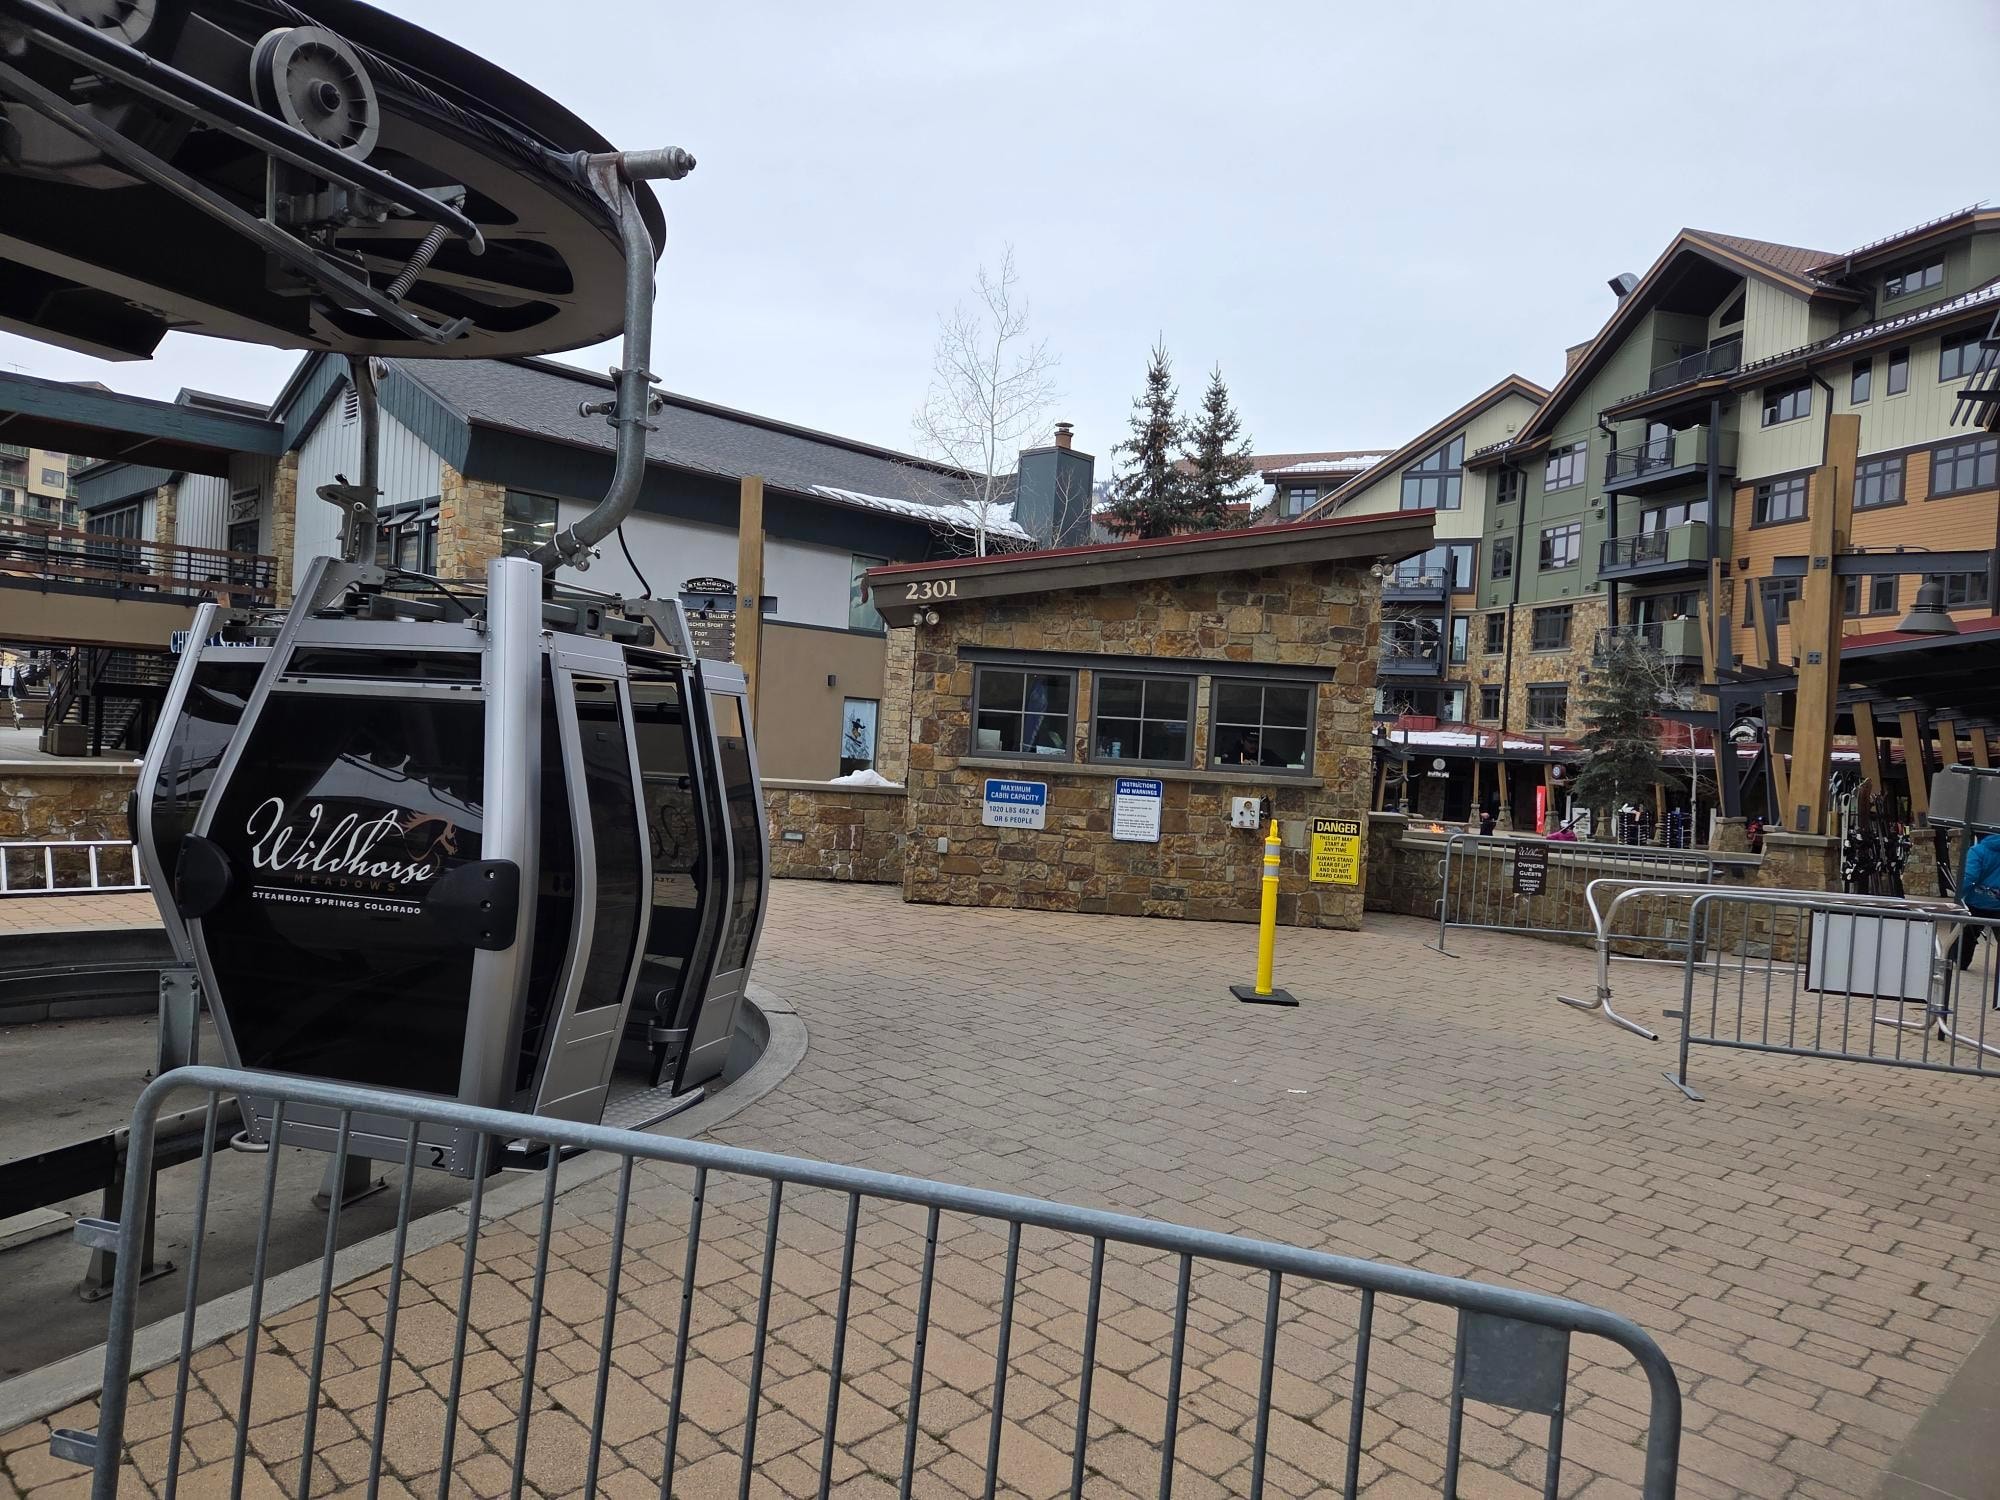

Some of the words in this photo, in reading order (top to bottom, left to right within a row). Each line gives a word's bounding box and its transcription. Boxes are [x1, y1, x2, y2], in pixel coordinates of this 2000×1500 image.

[905, 579, 958, 600] 2301
[1000, 784, 1031, 793] MAXIMUM
[1121, 781, 1157, 789] INSTRUCTIONS
[990, 791, 1009, 799] CABIN
[1010, 793, 1040, 802] CAPACITY
[989, 805, 1004, 813] 1020
[1005, 806, 1017, 814] LBS
[1010, 816, 1033, 825] PEOPLE
[1316, 821, 1358, 834] DANGER
[246, 797, 434, 884] Wildhorse
[1519, 870, 1542, 878] GUESTS
[294, 873, 396, 892] MEADOWS
[252, 891, 312, 904] STEAMBOAT
[314, 897, 360, 909] SPRINGS
[364, 902, 422, 915] COLORADO
[430, 1147, 446, 1169] 2
